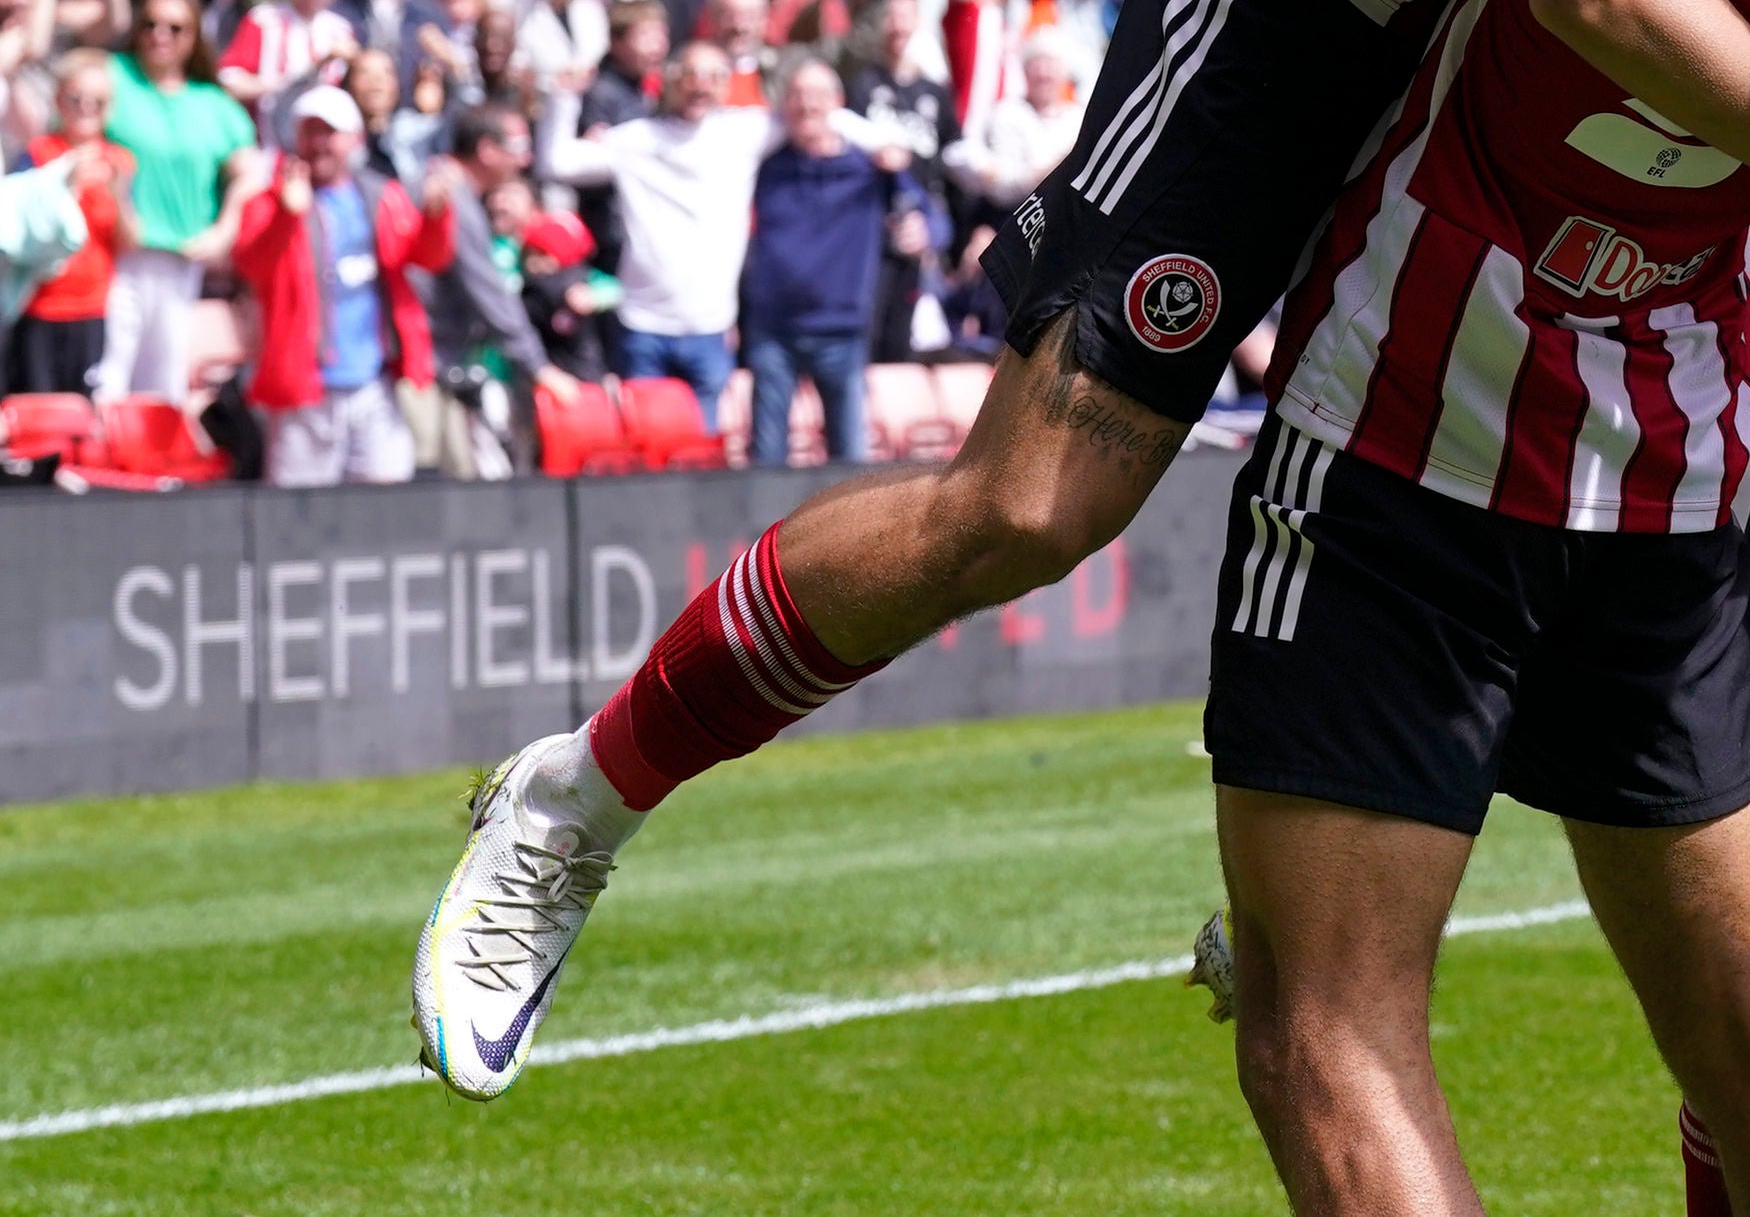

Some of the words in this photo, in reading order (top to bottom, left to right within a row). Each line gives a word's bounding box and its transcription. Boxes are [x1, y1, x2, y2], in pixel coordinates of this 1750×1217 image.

[1646, 166, 1666, 178] EFL
[1142, 261, 1196, 283] SHEFFIELD
[1196, 270, 1214, 305] UNITED
[1142, 325, 1161, 343] 1889
[113, 542, 658, 711] SHEFFIELD
